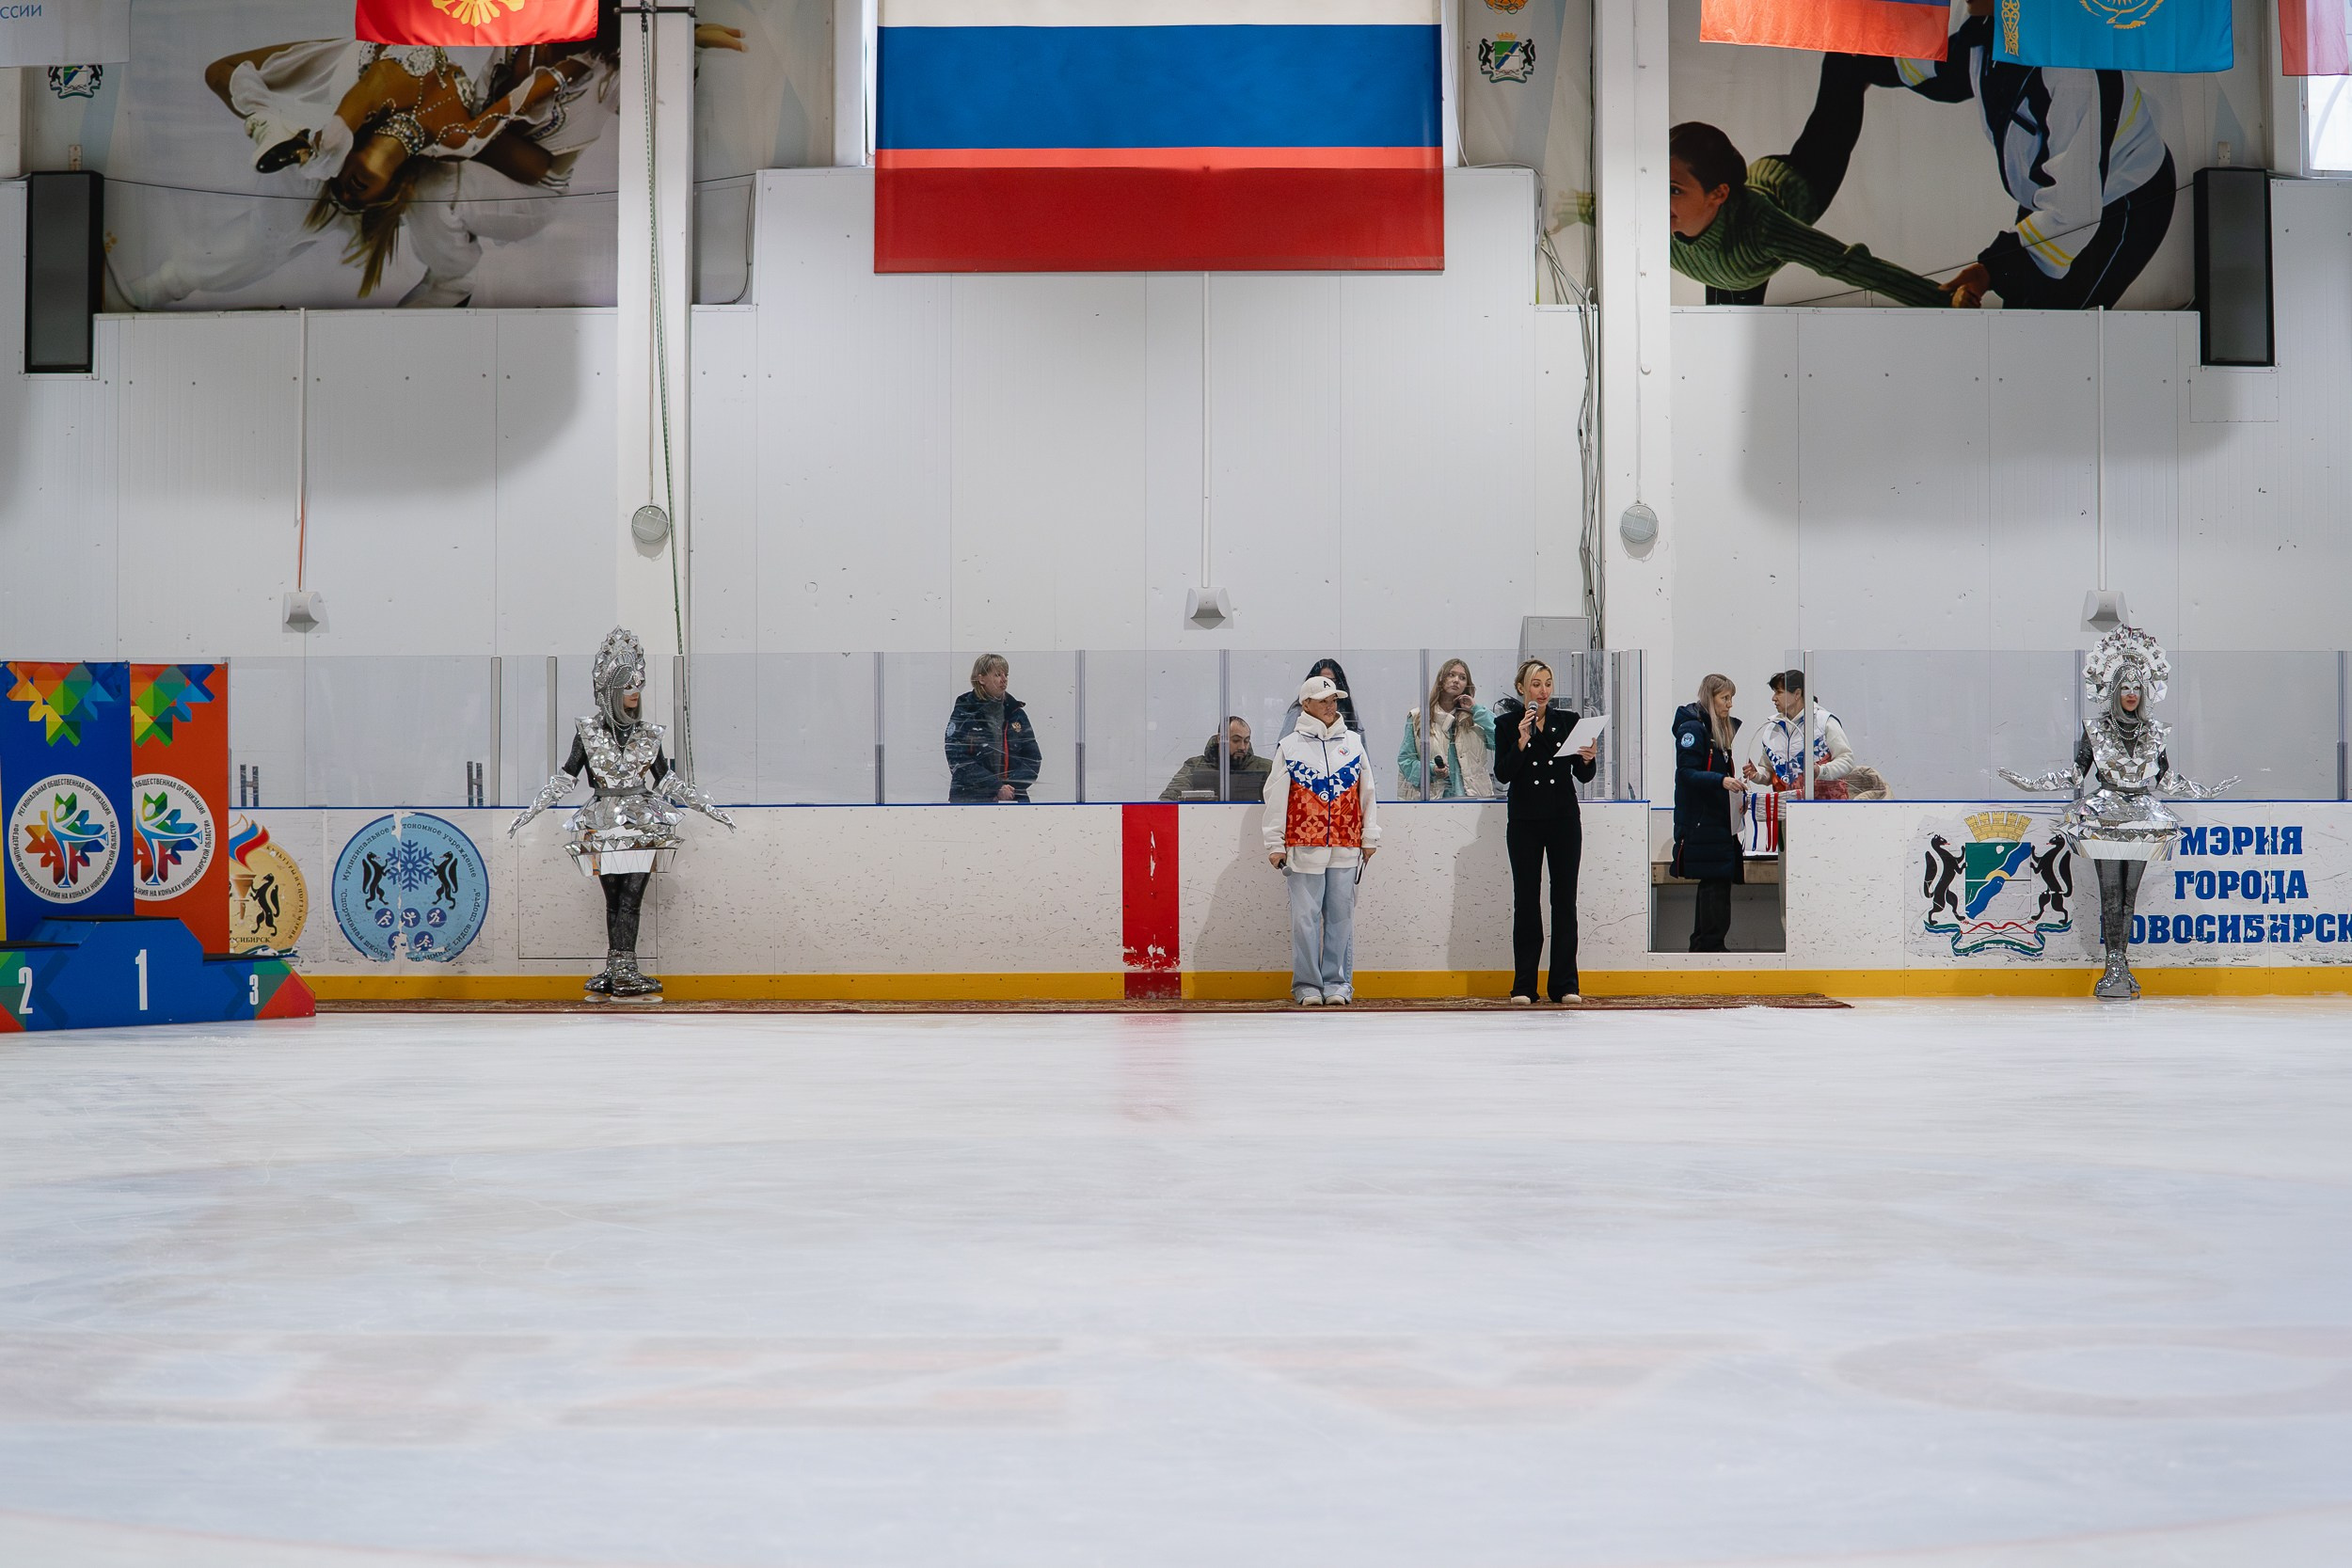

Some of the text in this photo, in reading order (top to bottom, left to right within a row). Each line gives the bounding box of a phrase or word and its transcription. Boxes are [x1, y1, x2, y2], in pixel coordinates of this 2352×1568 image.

[1323, 680, 1331, 689] A
[18, 778, 112, 817] РЕГИОНАЛЬНАЯ ОБЩЕСТВЕННАЯ ОРГАНИЗАЦИЯ
[135, 778, 206, 816] ОБЩЕСТВЕННАЯ ОРГАНИЗАЦИЯ
[342, 822, 477, 881] Муниципальное атономное учреждение
[2179, 825, 2303, 856] МЭРИЯ
[18, 863, 40, 890] ФИГУРНОГО
[39, 886, 61, 899] КАТАНИЯ
[69, 887, 91, 899] КОНЬКАХ
[134, 887, 149, 896] АНИЯ
[158, 884, 183, 896] КОНЬКАХ
[2174, 869, 2310, 905] ГОРОДА
[2099, 913, 2352, 944] ОВОСИБИРСК
[18, 966, 34, 1015] 2
[135, 948, 149, 1011] 1
[248, 974, 260, 1006] 3
